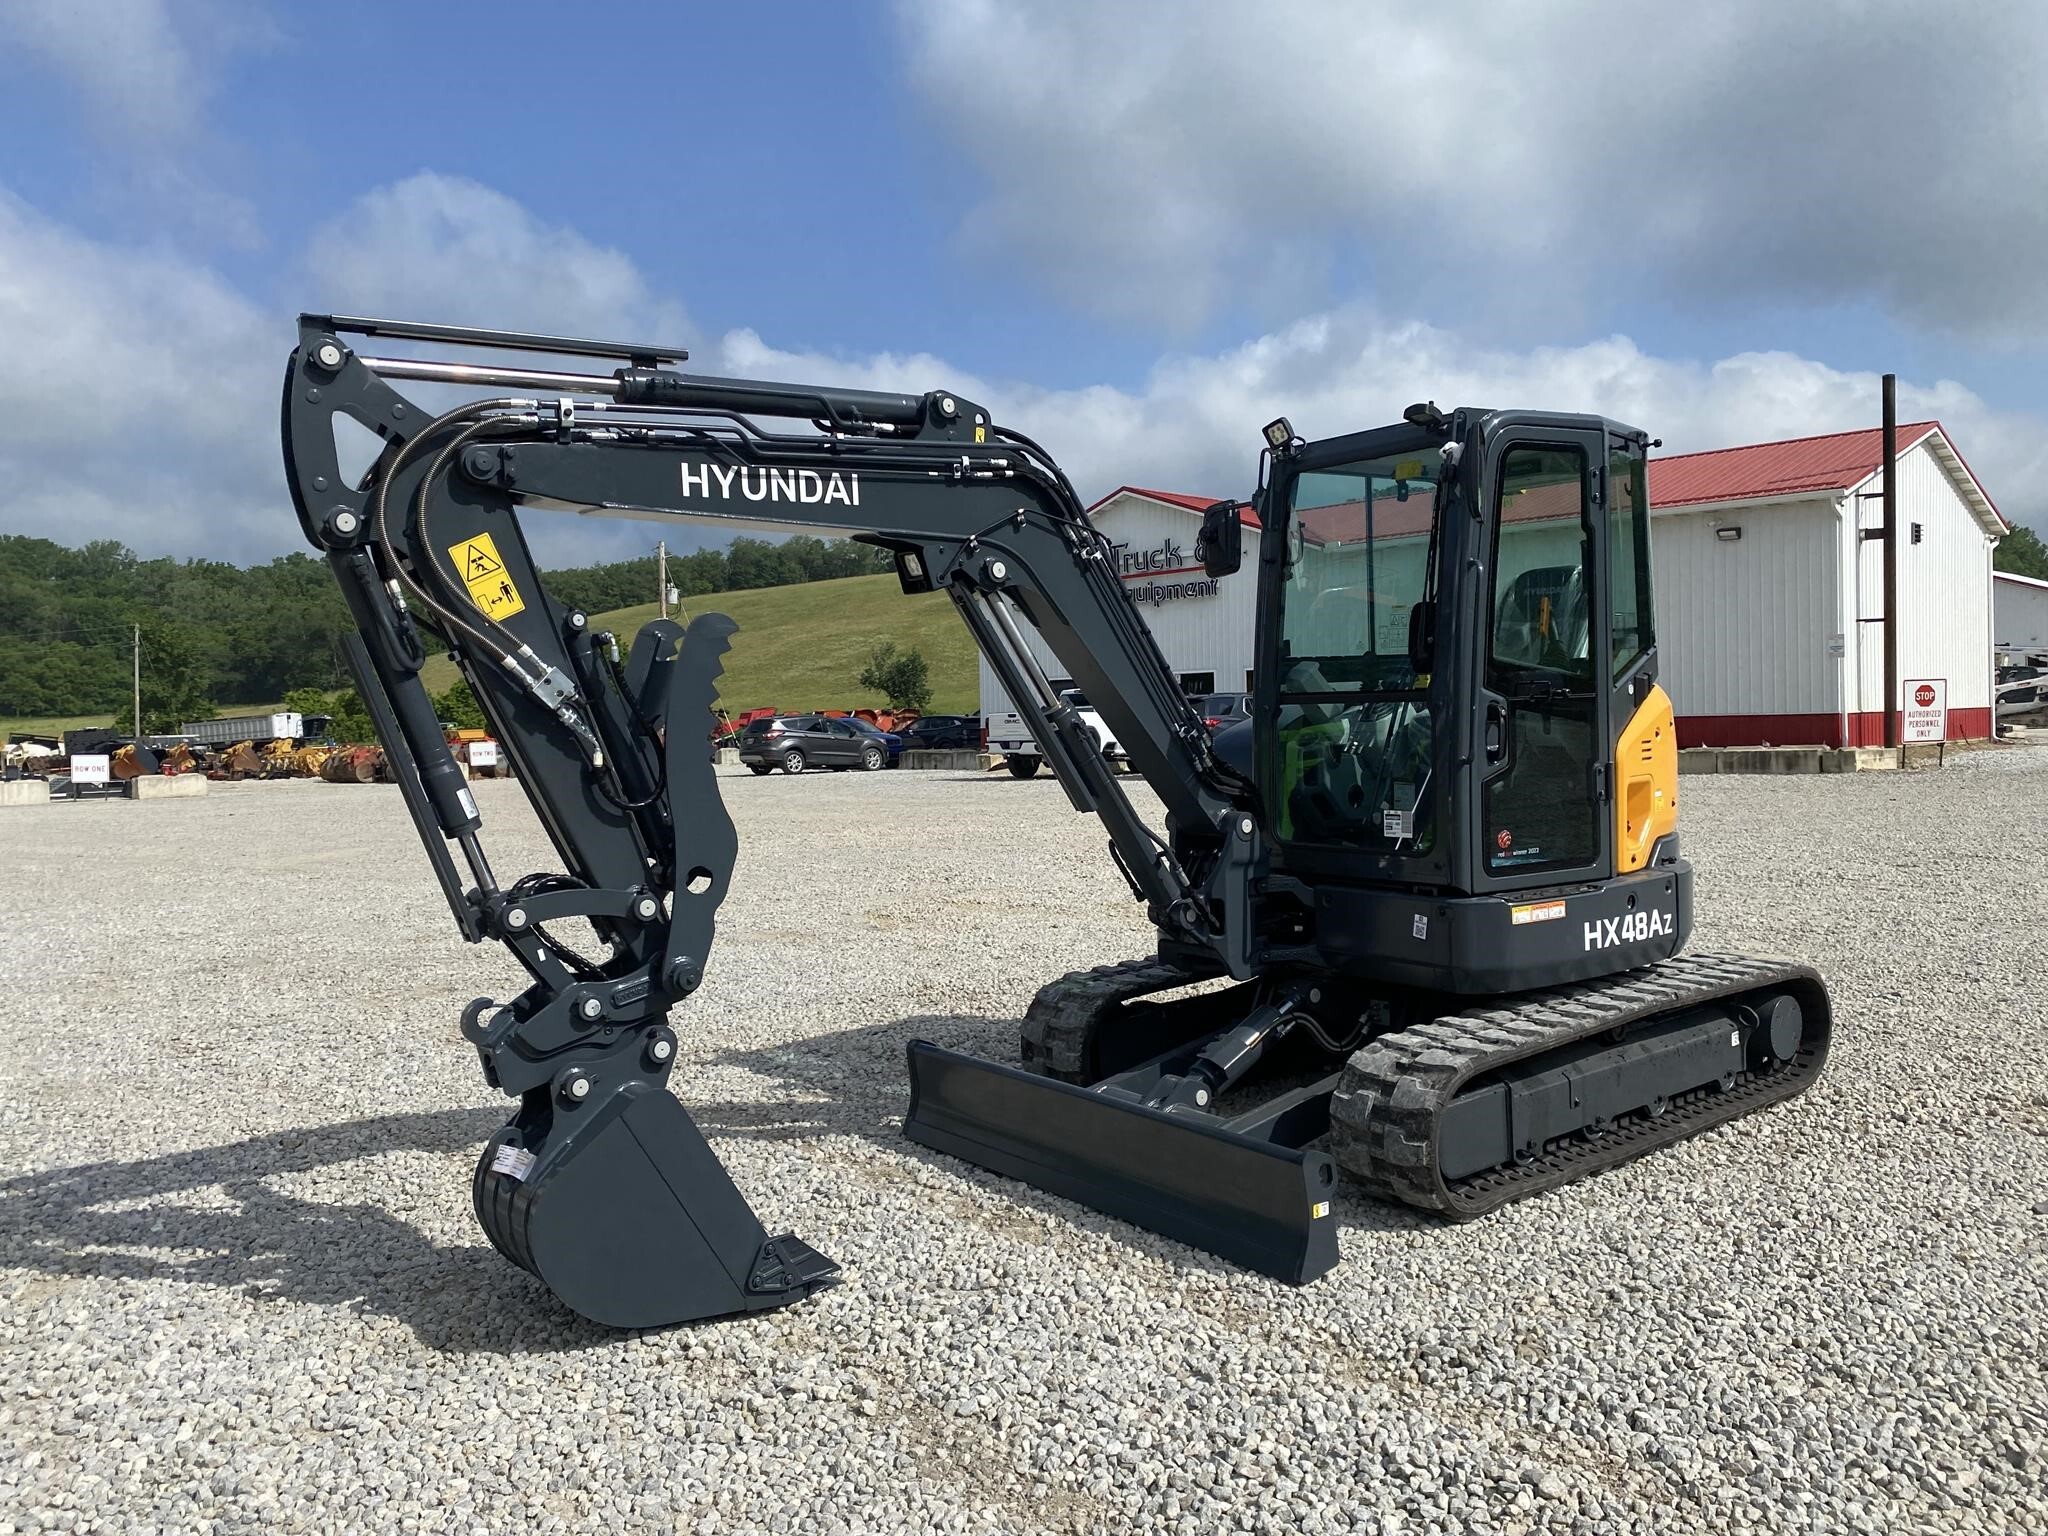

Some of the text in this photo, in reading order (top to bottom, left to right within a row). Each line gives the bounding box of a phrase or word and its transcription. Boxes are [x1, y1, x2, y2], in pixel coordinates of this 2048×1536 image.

[681, 462, 860, 506] HYUNDAI
[1111, 538, 1183, 573] Truck
[1915, 691, 1935, 701] STOP
[1908, 710, 1942, 719] AUTHORIZED
[1908, 719, 1941, 728] PERSONNEL
[1916, 730, 1931, 738] ONLY
[74, 765, 106, 773] ROW ONE
